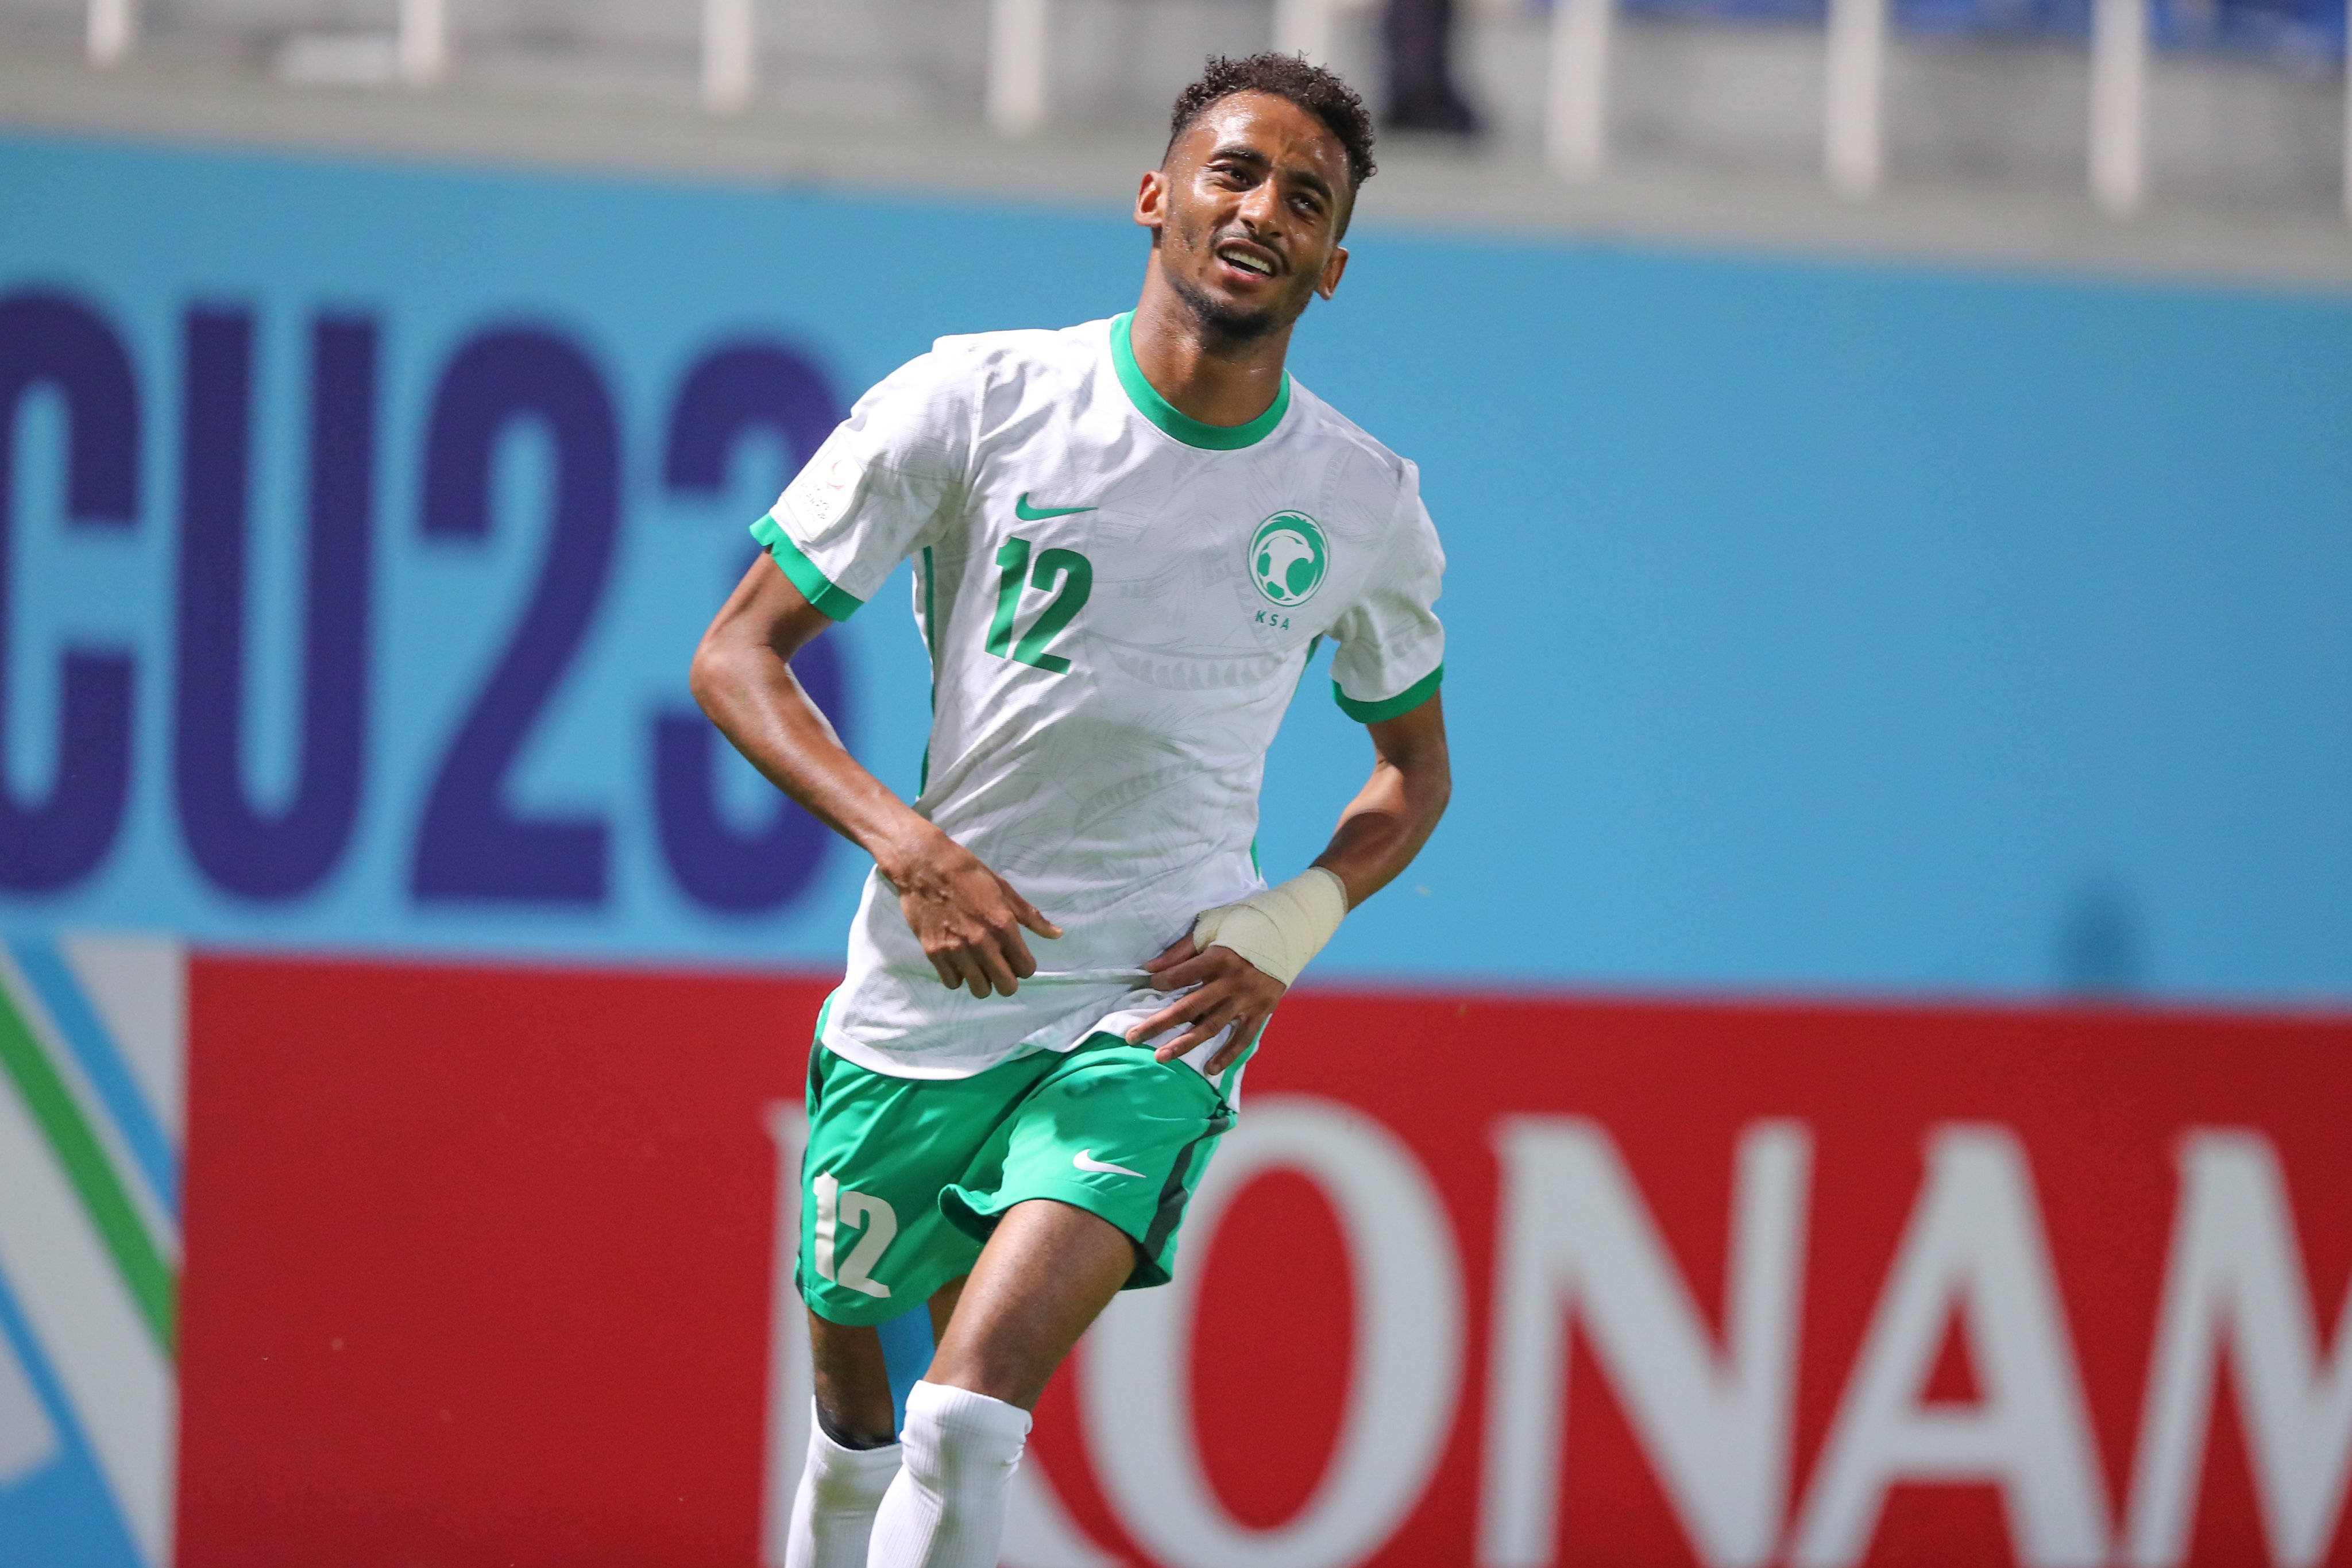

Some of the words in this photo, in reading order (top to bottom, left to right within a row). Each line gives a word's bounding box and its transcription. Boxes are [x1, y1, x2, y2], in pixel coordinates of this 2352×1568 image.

[984, 536, 1093, 675] 12
[1254, 609, 1290, 631] KSA
[812, 1169, 897, 1298] 12
